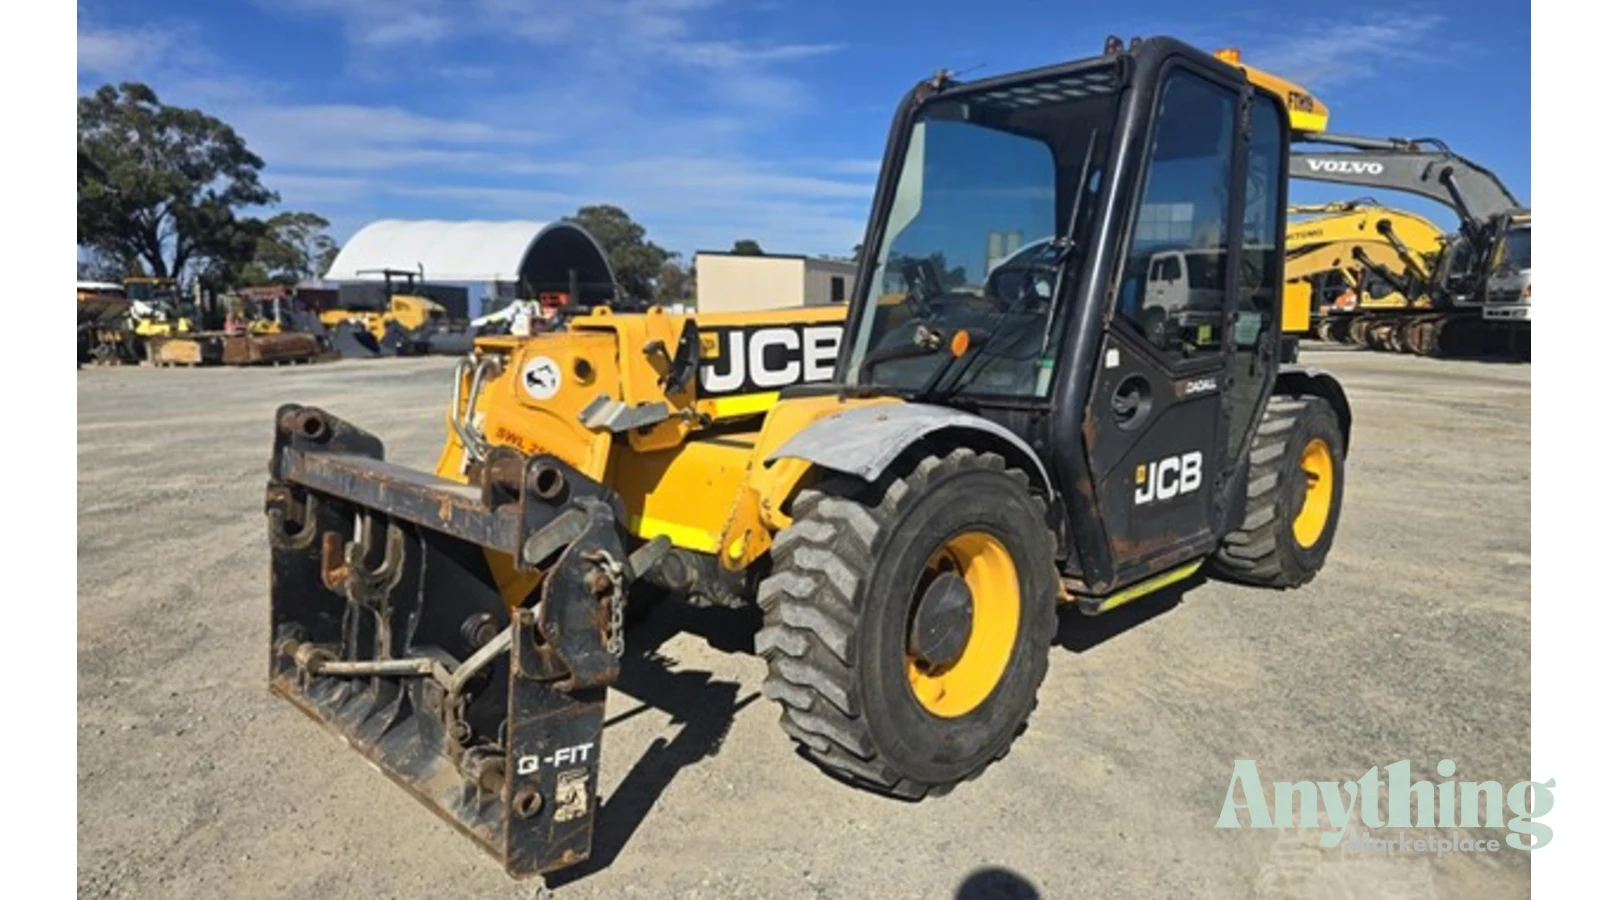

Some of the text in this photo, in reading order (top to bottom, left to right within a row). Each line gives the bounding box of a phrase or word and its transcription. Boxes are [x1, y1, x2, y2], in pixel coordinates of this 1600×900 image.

[1307, 158, 1383, 174] VOLVO
[700, 326, 844, 392] JCB
[1134, 451, 1203, 505] JCB
